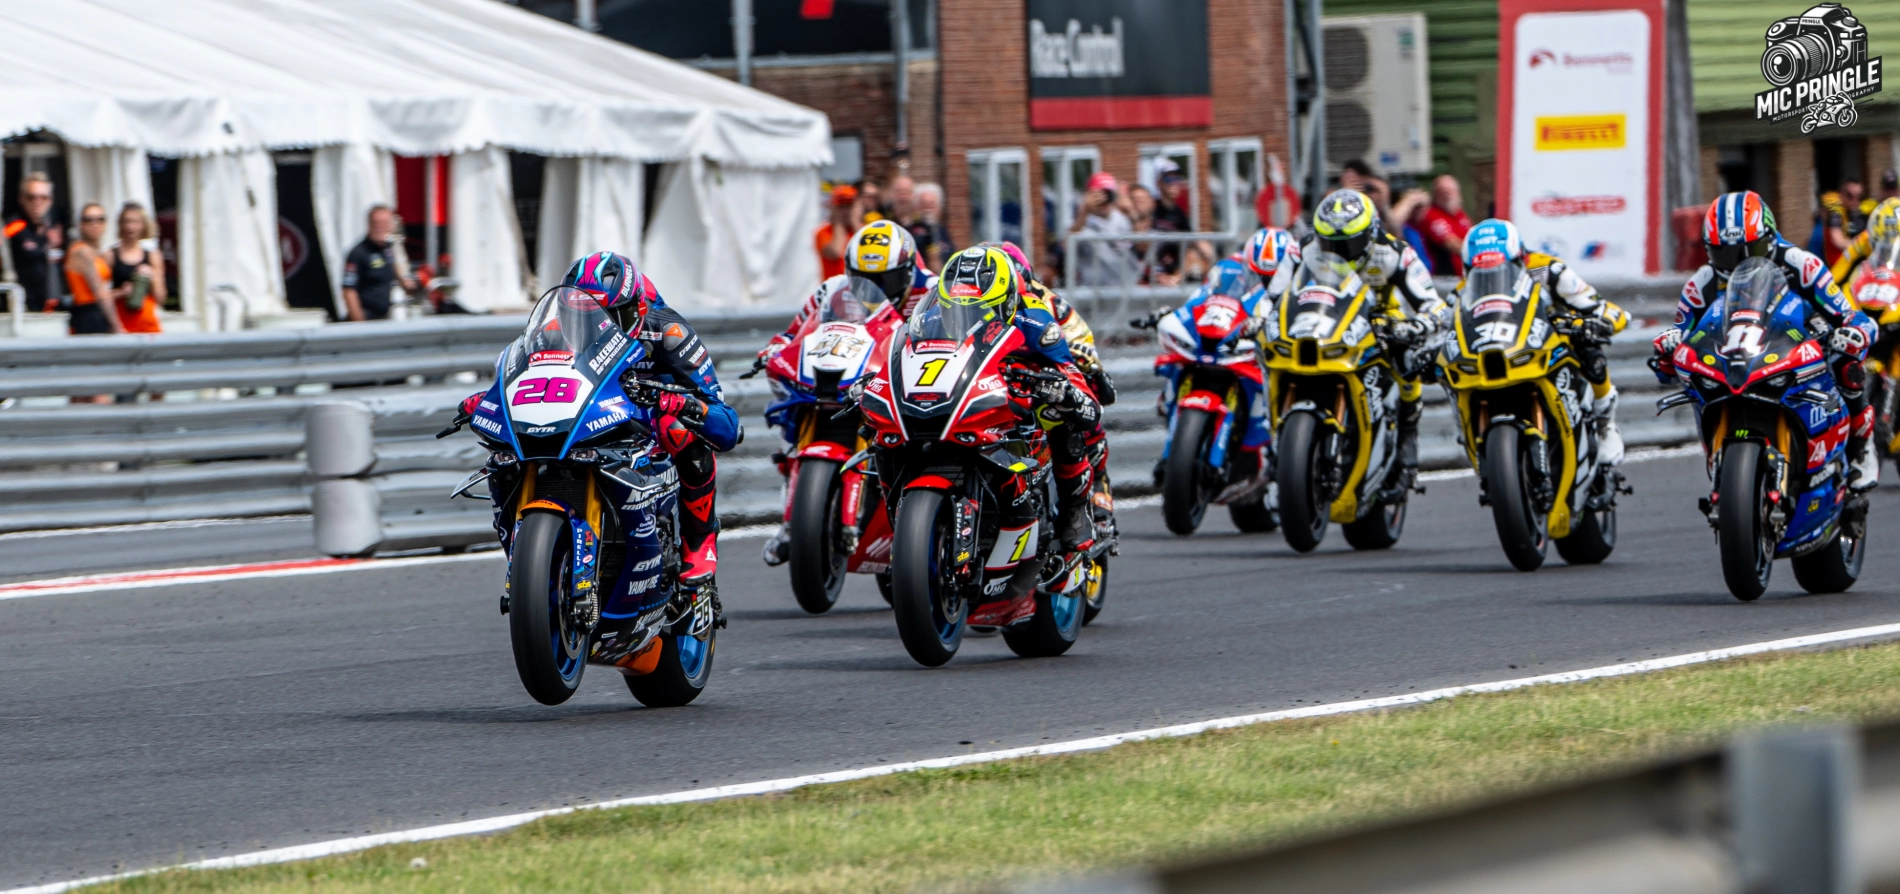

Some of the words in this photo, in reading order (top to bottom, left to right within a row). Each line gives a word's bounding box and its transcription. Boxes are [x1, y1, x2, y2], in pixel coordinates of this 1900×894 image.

[621, 263, 634, 298] BURNELL
[1471, 321, 1518, 350] 30
[1720, 324, 1765, 355] 11
[914, 357, 949, 387] 1
[512, 377, 582, 406] 28
[472, 415, 502, 435] YAMAHA
[586, 411, 628, 432] YAMAHA
[957, 552, 969, 562] sbs
[1007, 527, 1032, 564] 1
